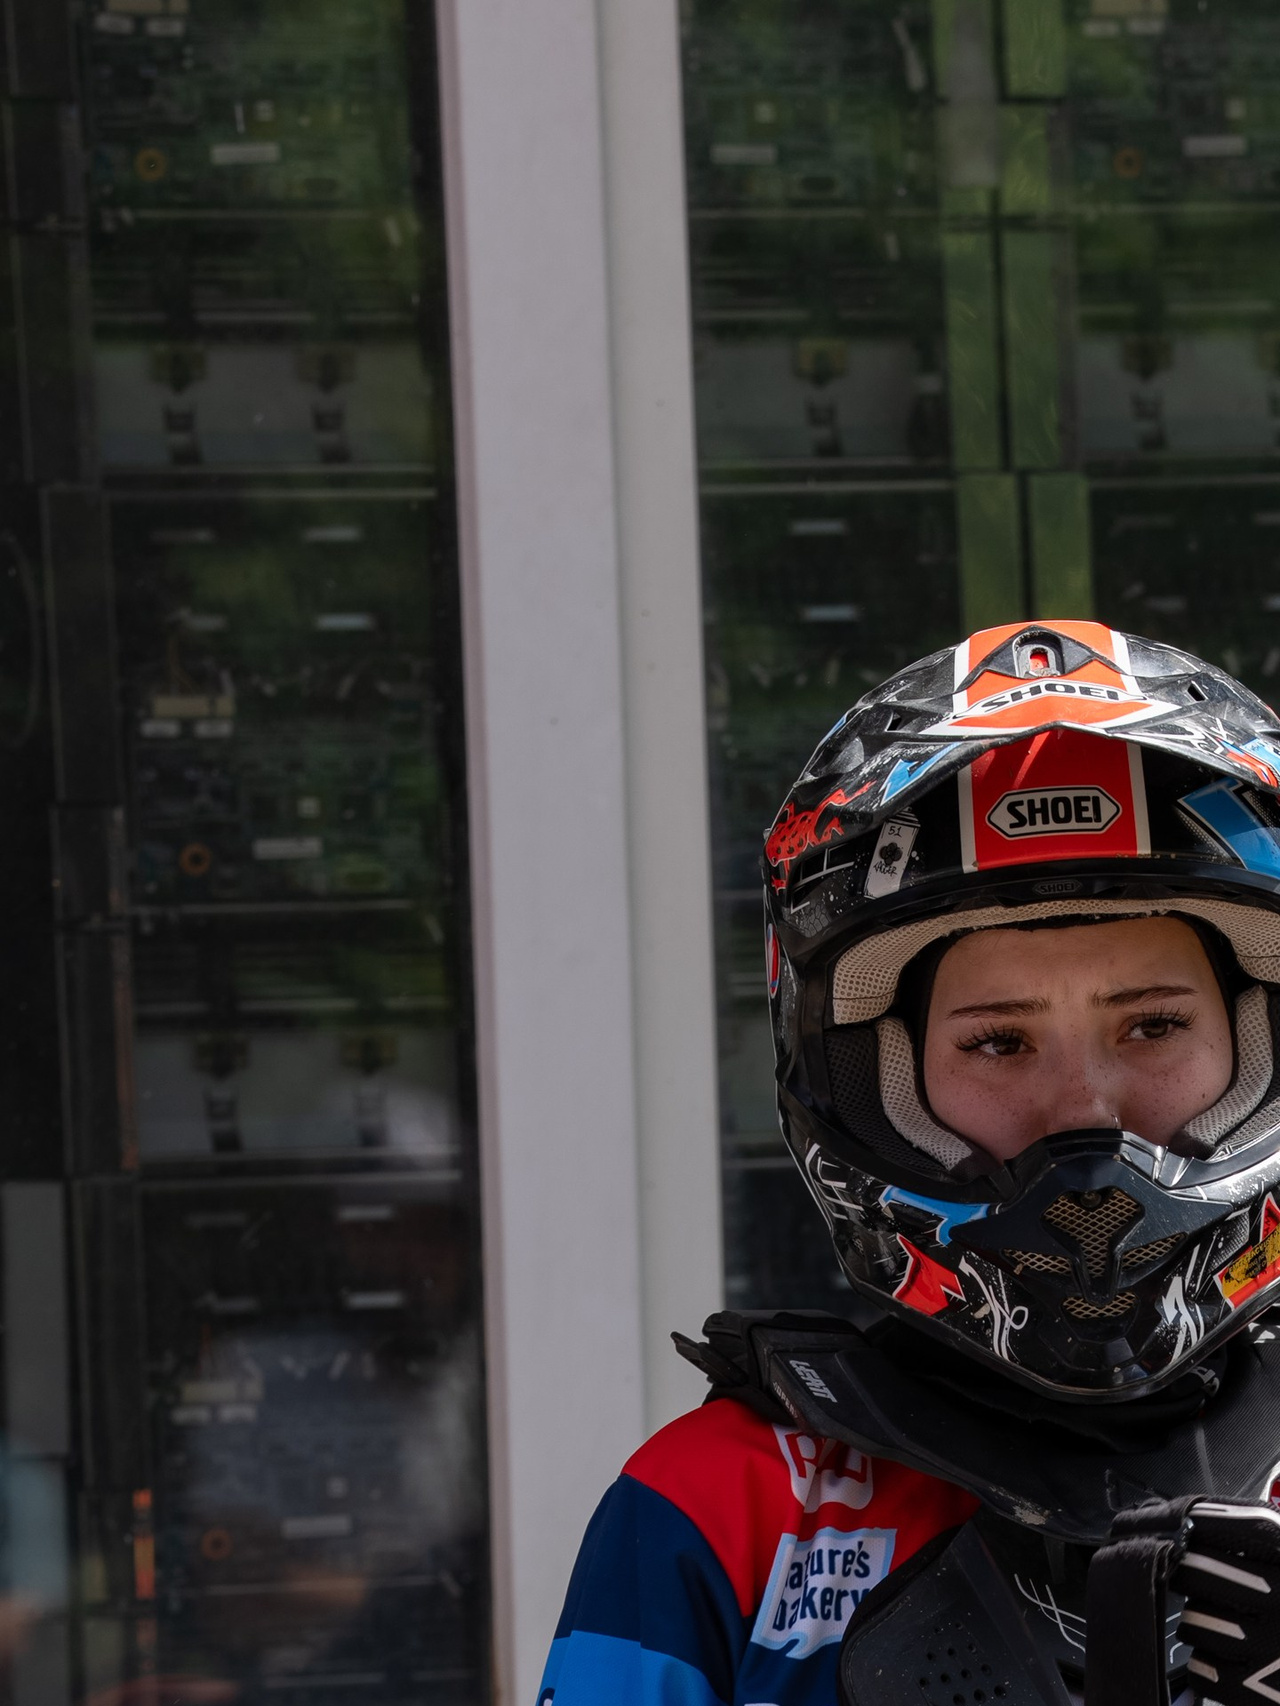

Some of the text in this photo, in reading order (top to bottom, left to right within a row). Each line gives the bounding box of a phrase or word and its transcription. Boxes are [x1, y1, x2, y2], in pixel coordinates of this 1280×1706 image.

[981, 683, 1119, 713] SHOEI
[1006, 795, 1102, 829] SHOEI
[1039, 880, 1075, 893] SHOEI
[789, 1359, 838, 1403] LEATT
[782, 1541, 870, 1590] ature's
